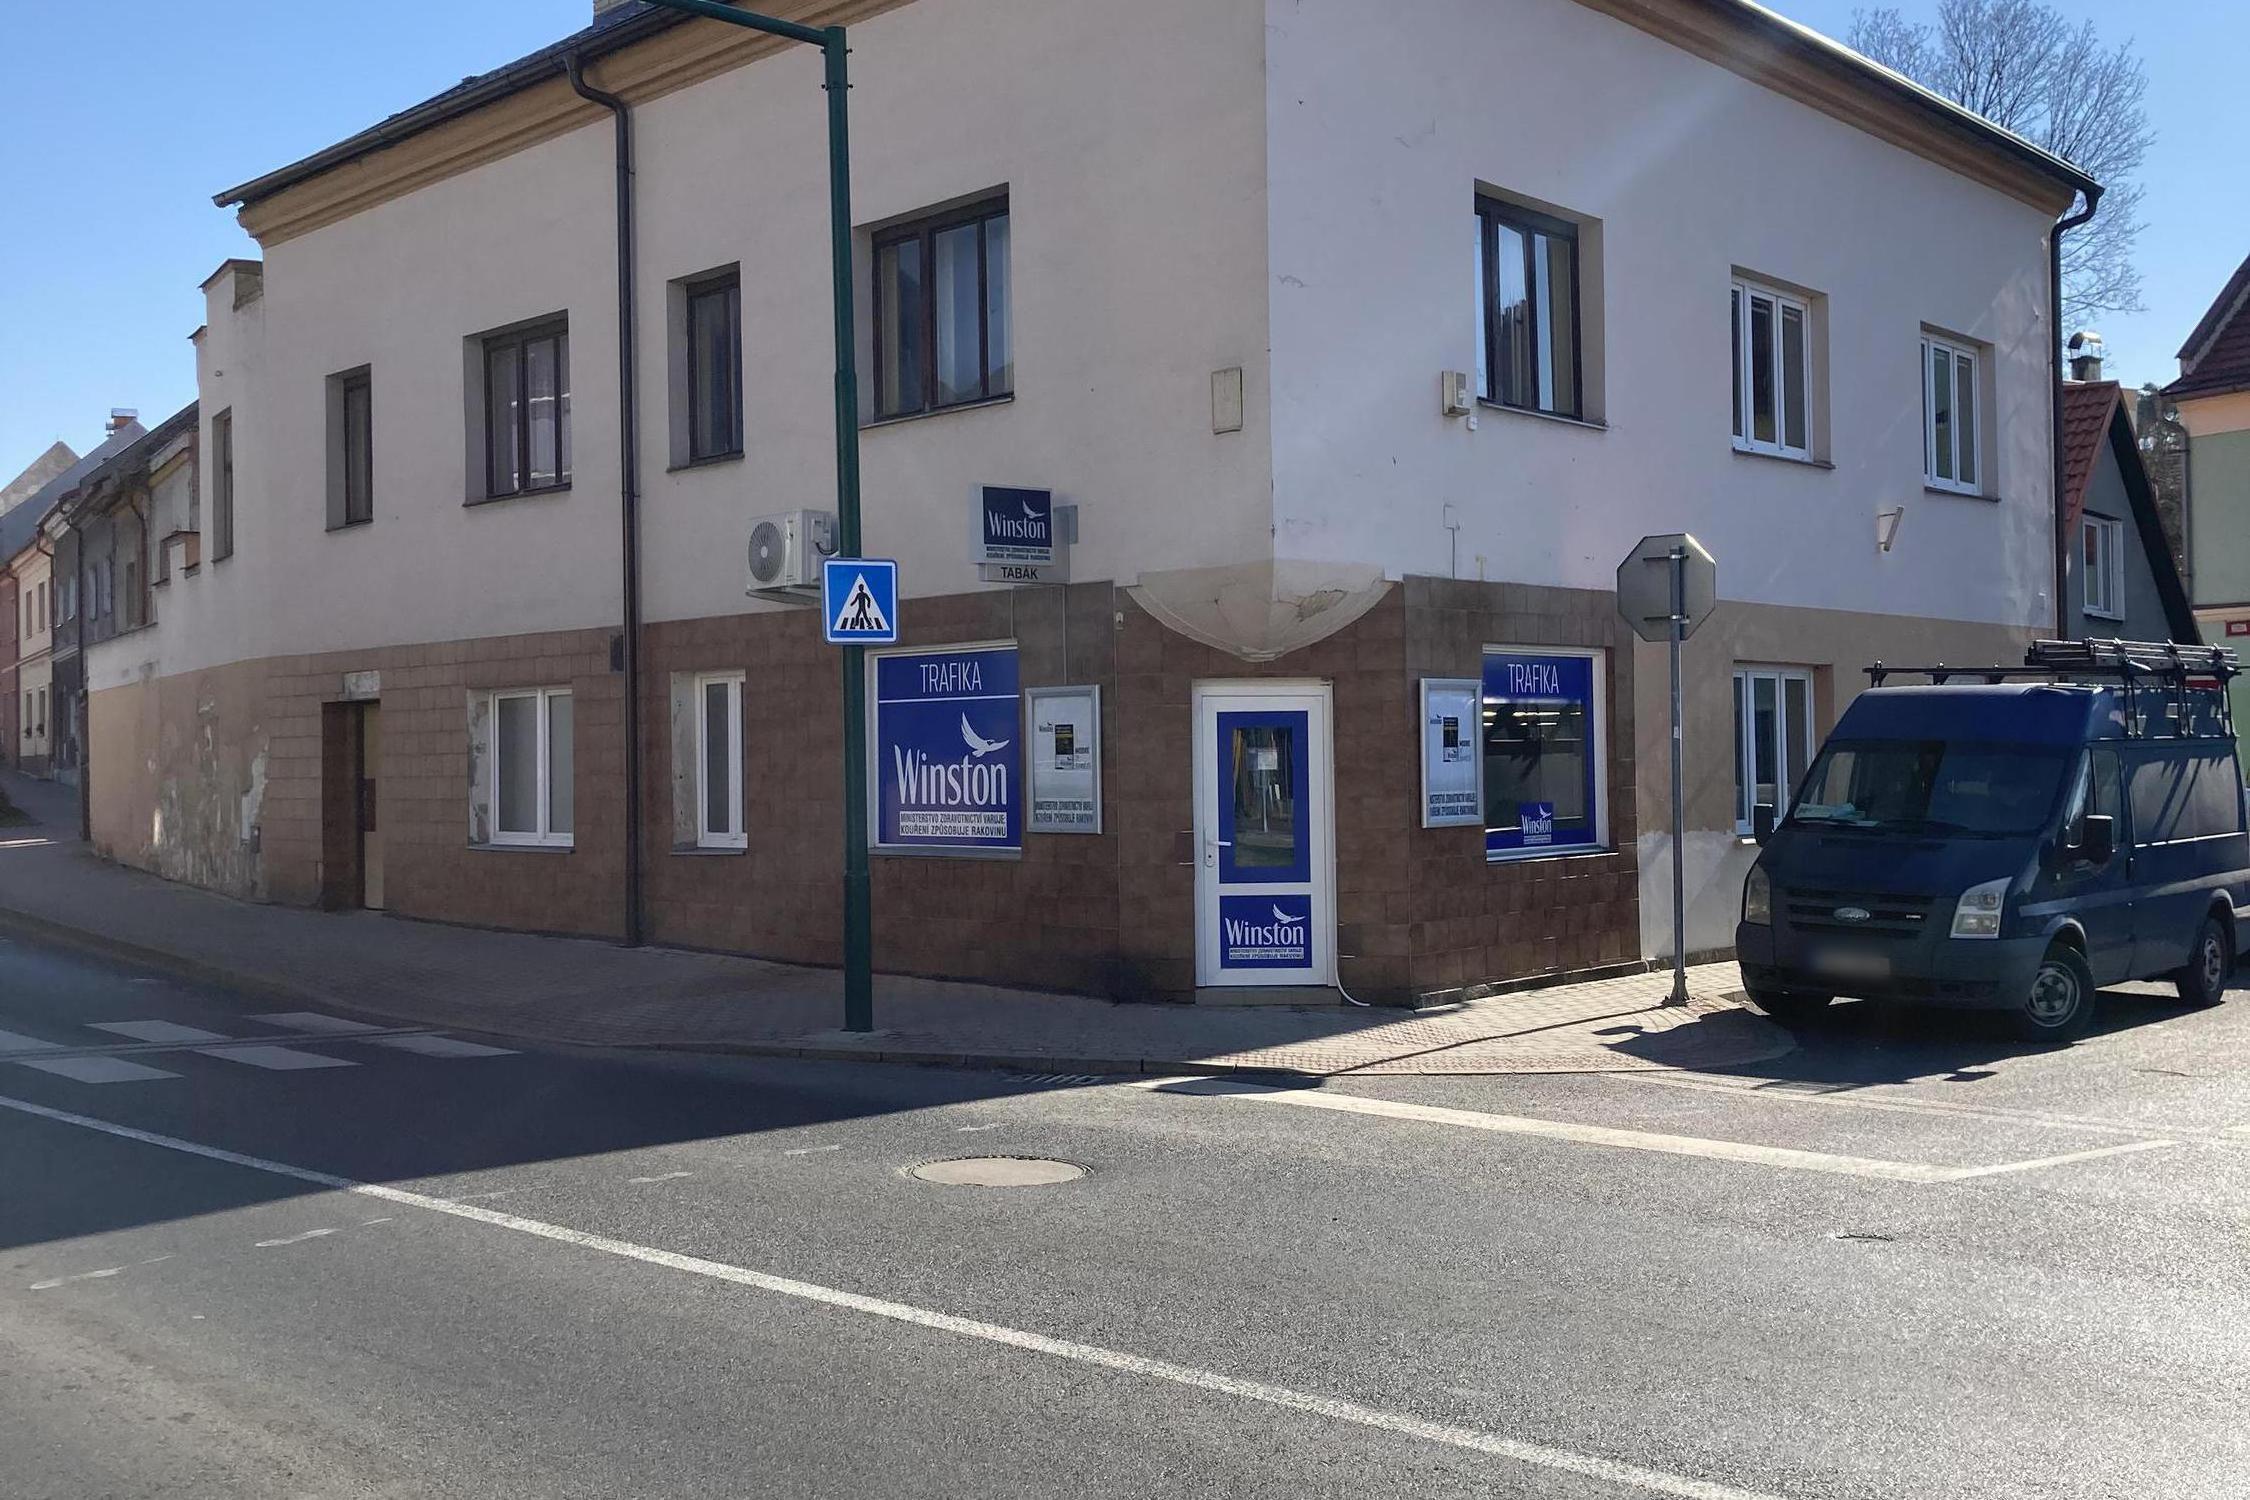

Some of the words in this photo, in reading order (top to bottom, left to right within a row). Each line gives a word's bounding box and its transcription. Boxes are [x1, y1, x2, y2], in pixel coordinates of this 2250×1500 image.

[988, 510, 1046, 539] Winston
[920, 661, 982, 693] TRAFIKA
[1507, 663, 1560, 694] TRAFIKA
[894, 744, 1007, 805] Winston
[1521, 814, 1552, 834] Winston
[1225, 917, 1304, 946] Winston
